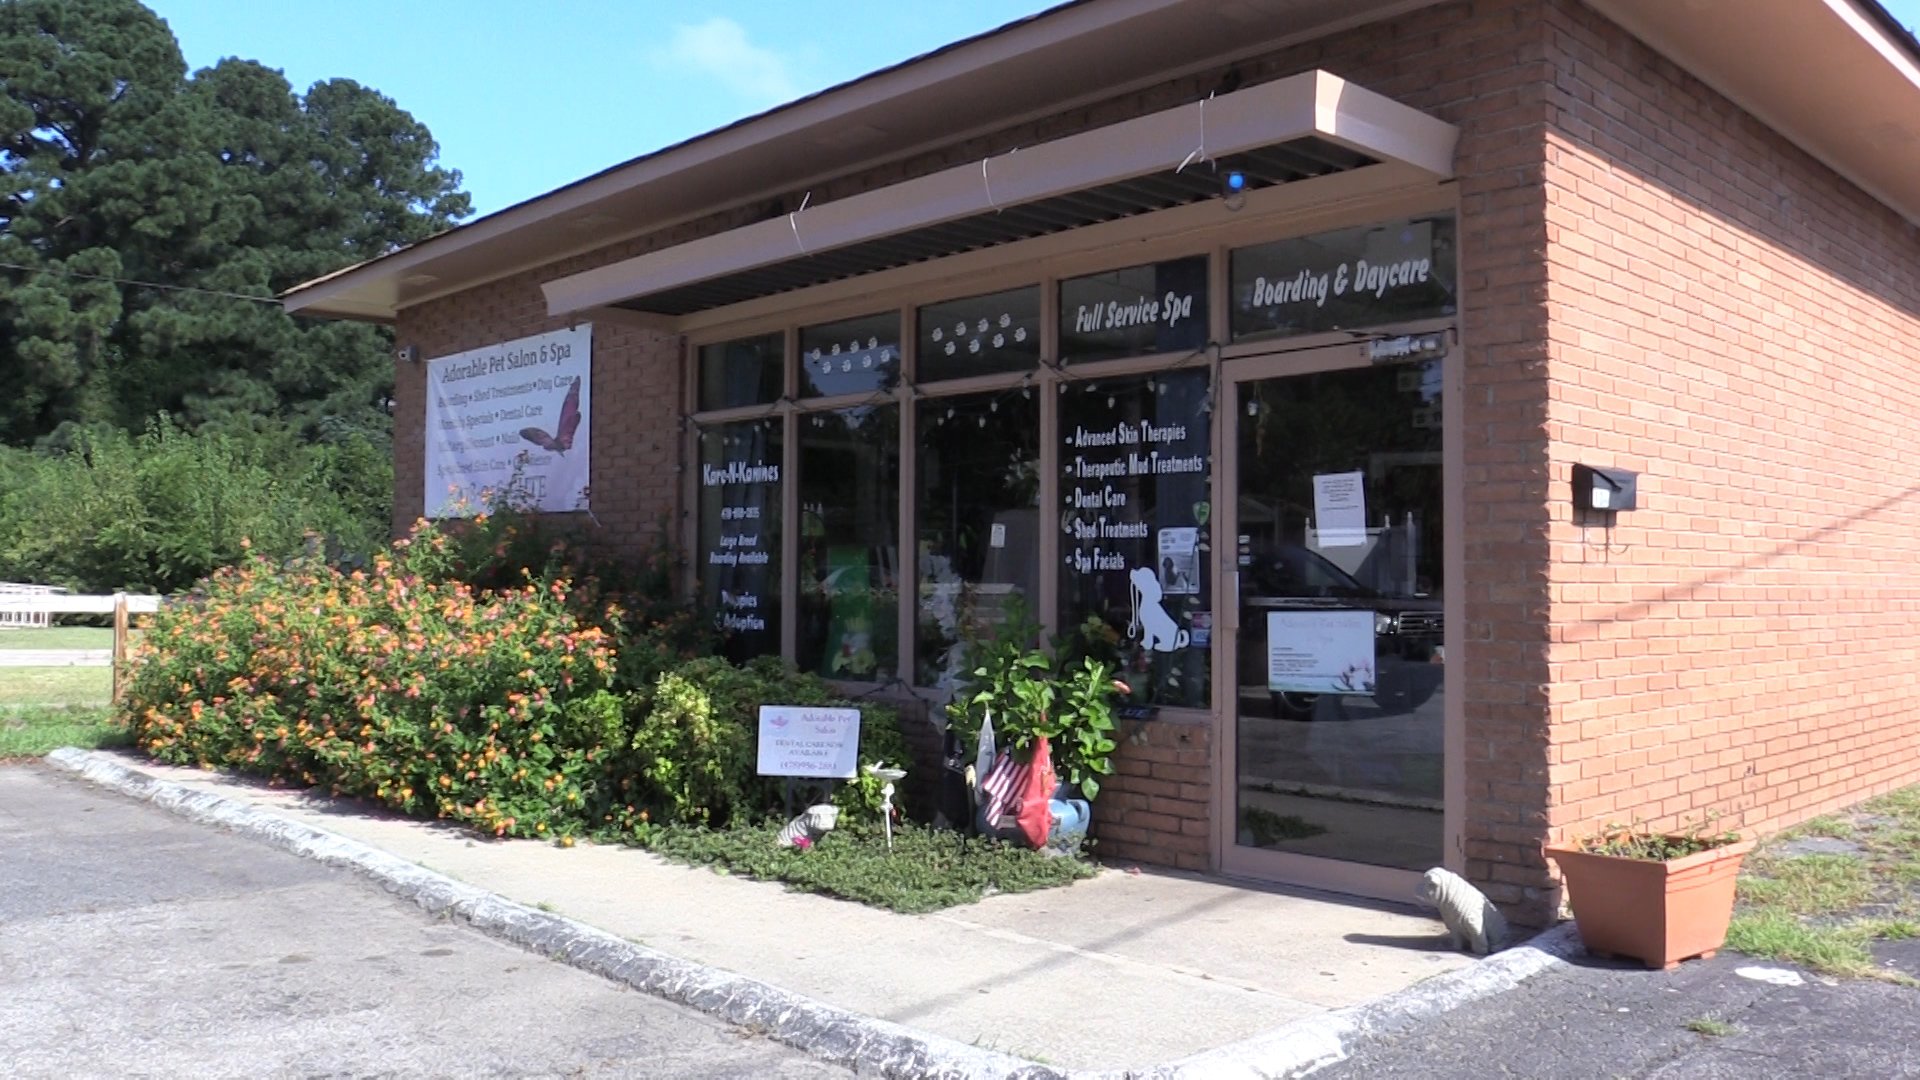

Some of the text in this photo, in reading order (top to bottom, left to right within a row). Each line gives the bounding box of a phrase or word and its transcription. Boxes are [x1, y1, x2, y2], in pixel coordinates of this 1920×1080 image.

[1253, 258, 1431, 308] Boarding & Daycare
[1075, 290, 1193, 333] Full Service Spa
[442, 341, 571, 383] Adorable Pet Salon & Spa
[525, 404, 543, 418] Care
[1075, 419, 1187, 448] Advanced Skin Therapies
[1075, 450, 1203, 481] Therapeutic Mud Treatments
[1075, 485, 1126, 508] Dental Care
[1075, 516, 1148, 540] Shed Treatments
[1075, 547, 1125, 575] Spa Facials
[721, 589, 758, 609] Ppies
